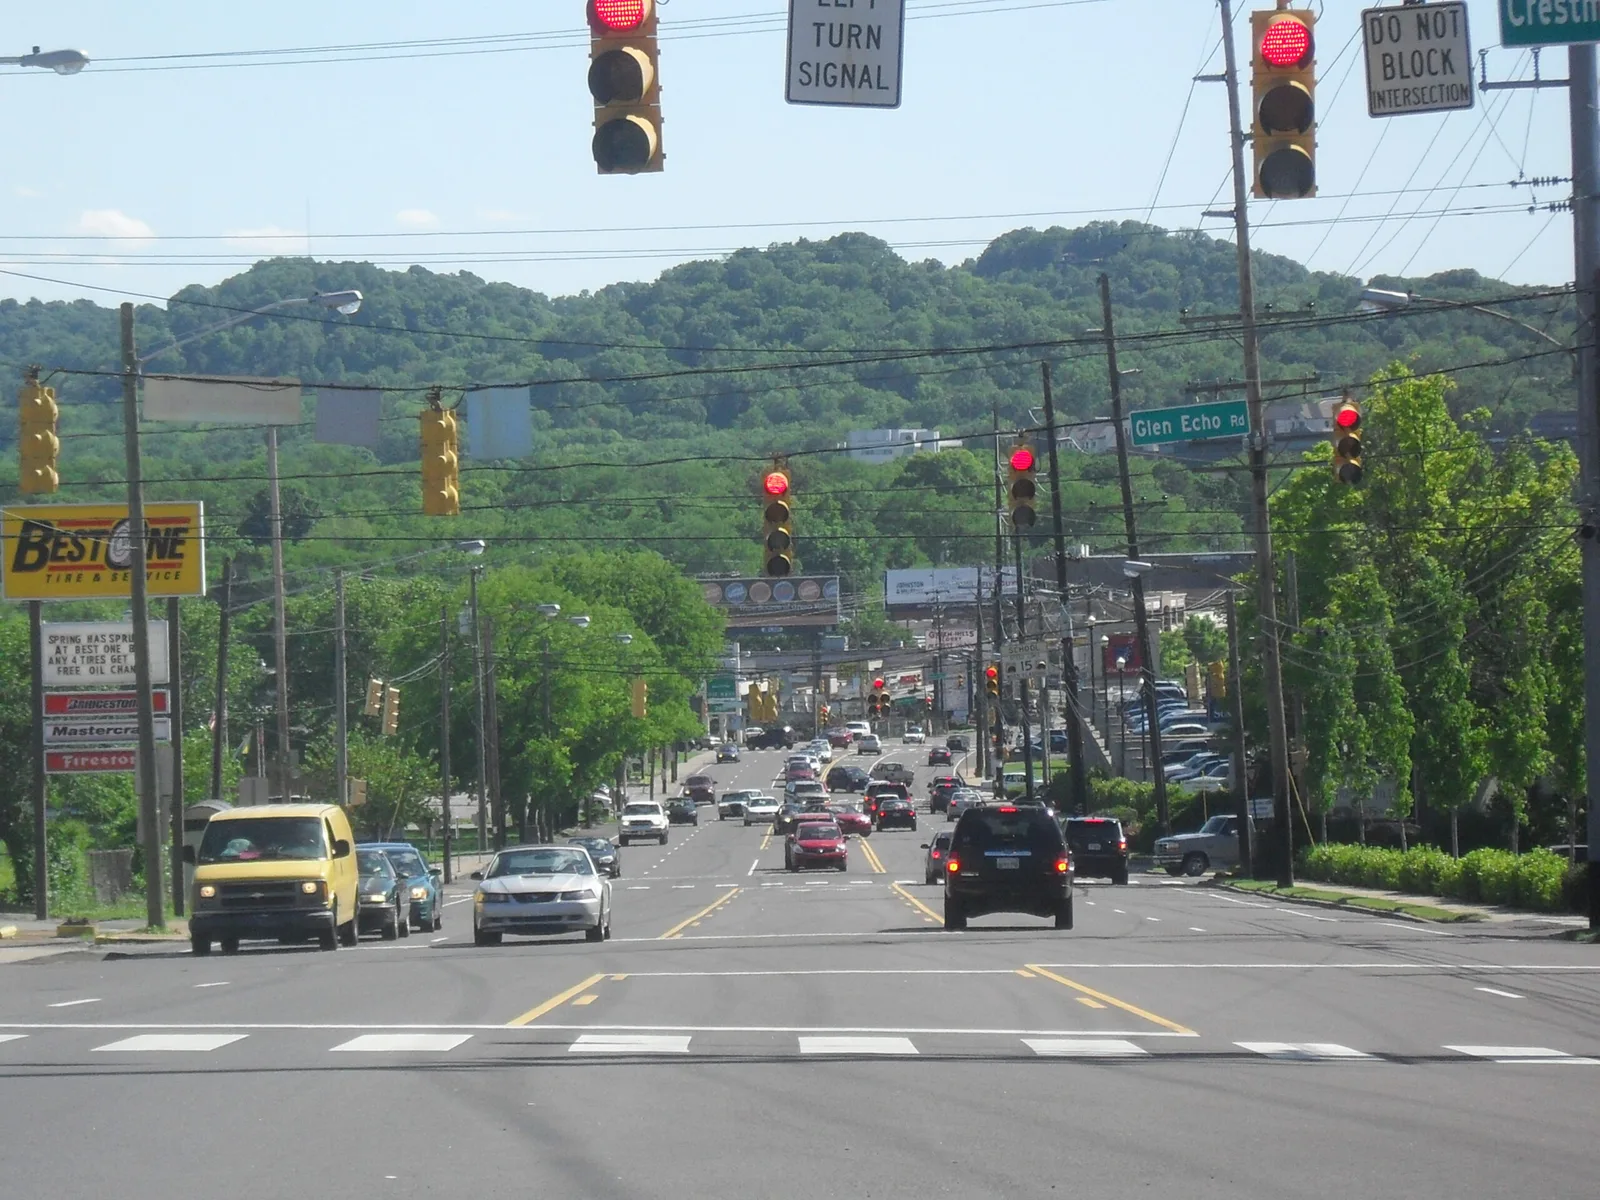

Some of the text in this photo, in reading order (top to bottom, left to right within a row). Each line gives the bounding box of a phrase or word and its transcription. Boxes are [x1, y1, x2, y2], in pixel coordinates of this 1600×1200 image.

[1370, 10, 1459, 45] DO NOT
[813, 22, 882, 50] TURN
[1382, 48, 1455, 81] BLOCK
[799, 61, 889, 90] SIGNAL
[1371, 83, 1469, 110] INTERSECTION
[1135, 414, 1245, 437] Glen Echo Rd
[46, 571, 181, 583] TIRE & SEVICE
[48, 634, 135, 644] SPRING HAS SPRU
[55, 646, 68, 654] AT
[75, 645, 98, 654] BEST
[104, 645, 121, 653] ONE
[1008, 644, 1040, 654] SCHOOL
[48, 655, 127, 665] ANY 4 TIRES GET
[1020, 660, 1033, 671] 15
[57, 665, 136, 675] FREE OIL CHAN
[69, 699, 138, 709] BRIDGESTON
[52, 726, 140, 736] Mastercra
